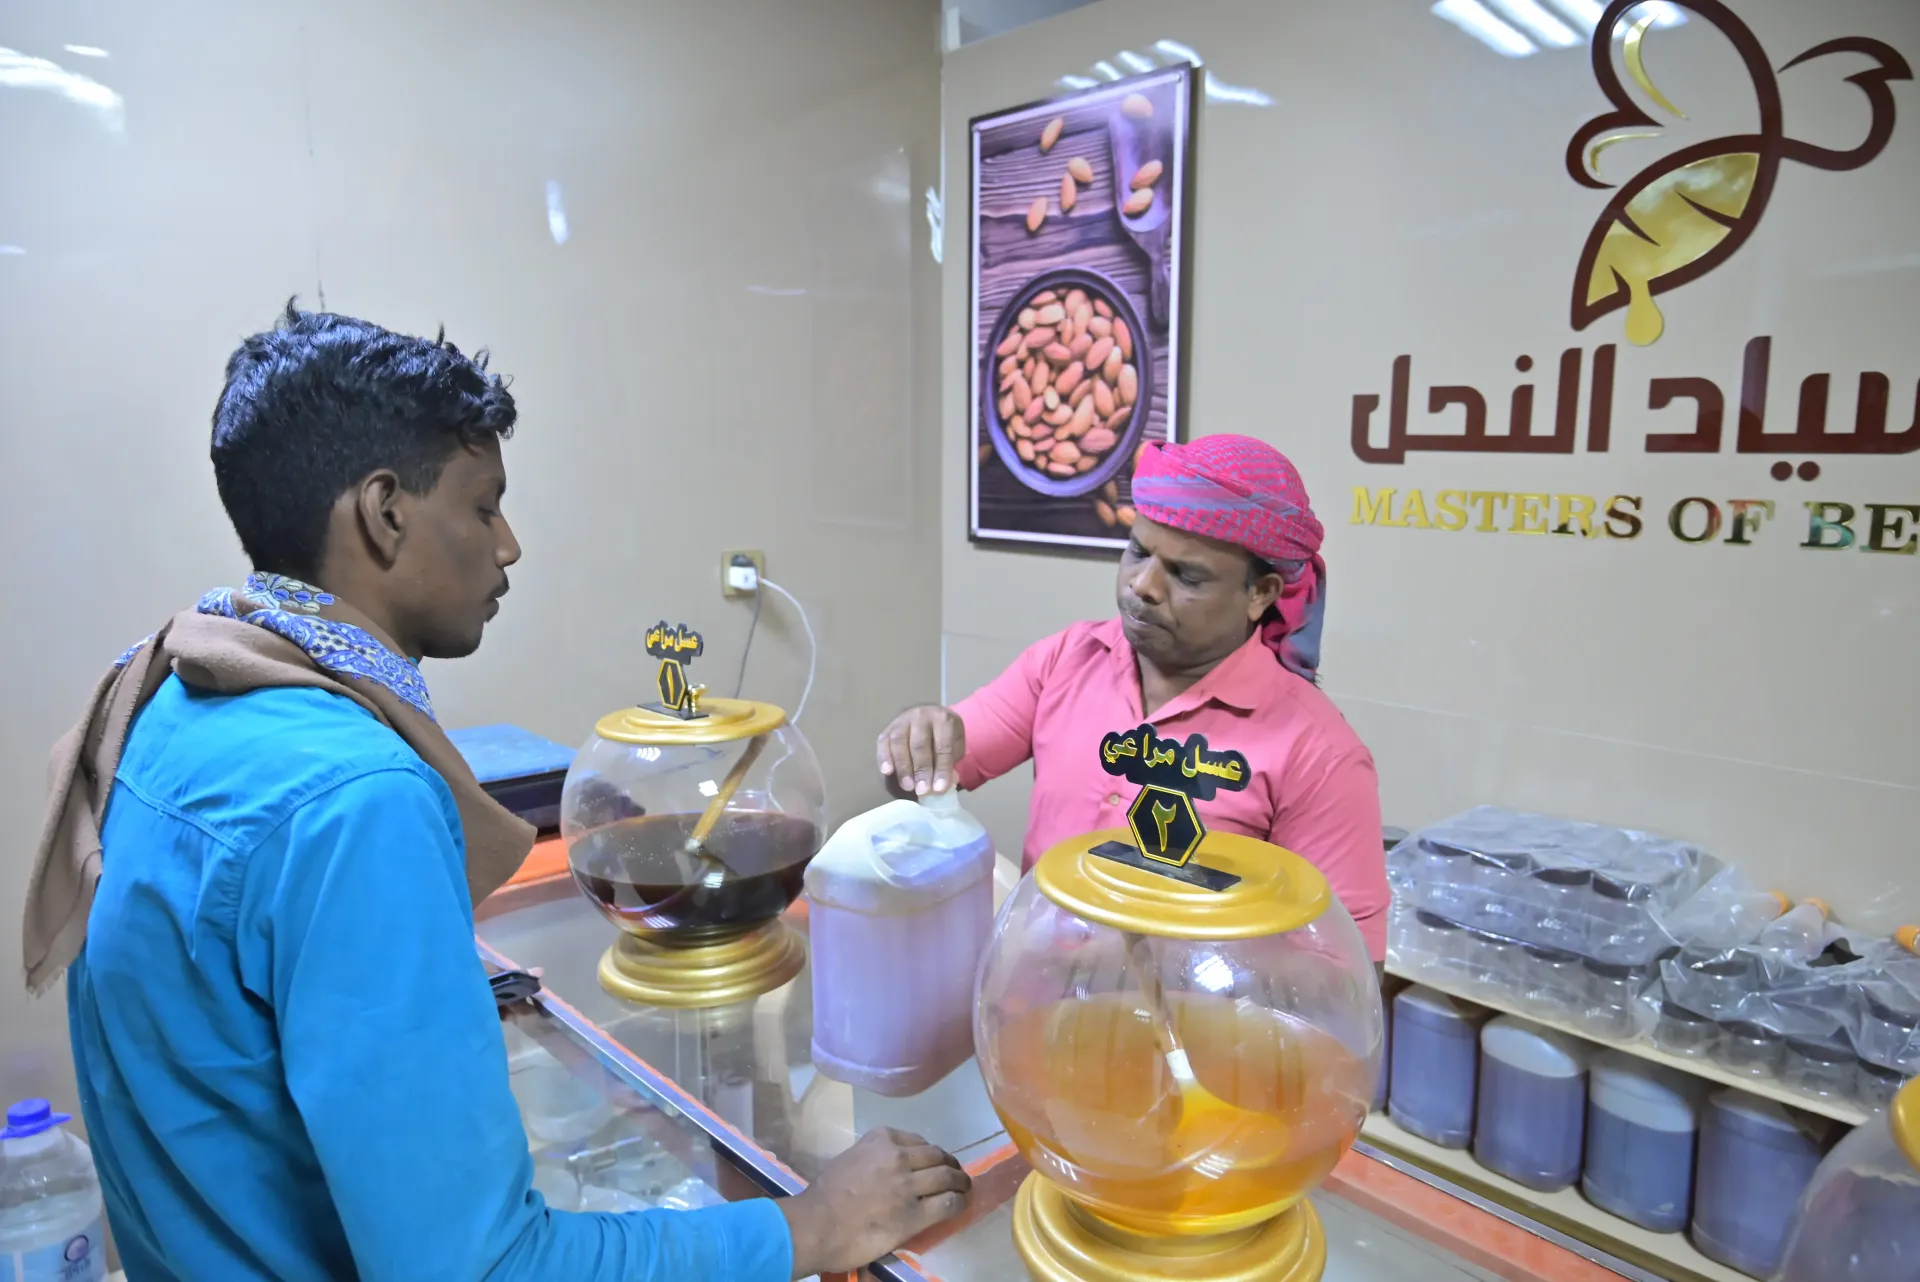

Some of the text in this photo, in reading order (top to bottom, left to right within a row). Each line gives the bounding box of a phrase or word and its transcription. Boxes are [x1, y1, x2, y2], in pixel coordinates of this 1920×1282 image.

[1350, 343, 1617, 465] النحل
[1348, 486, 1920, 556] MASTERS OF BE
[674, 628, 698, 652] عسل
[1103, 733, 1243, 781] عسل مراعي
[1151, 799, 1177, 853] ٢
